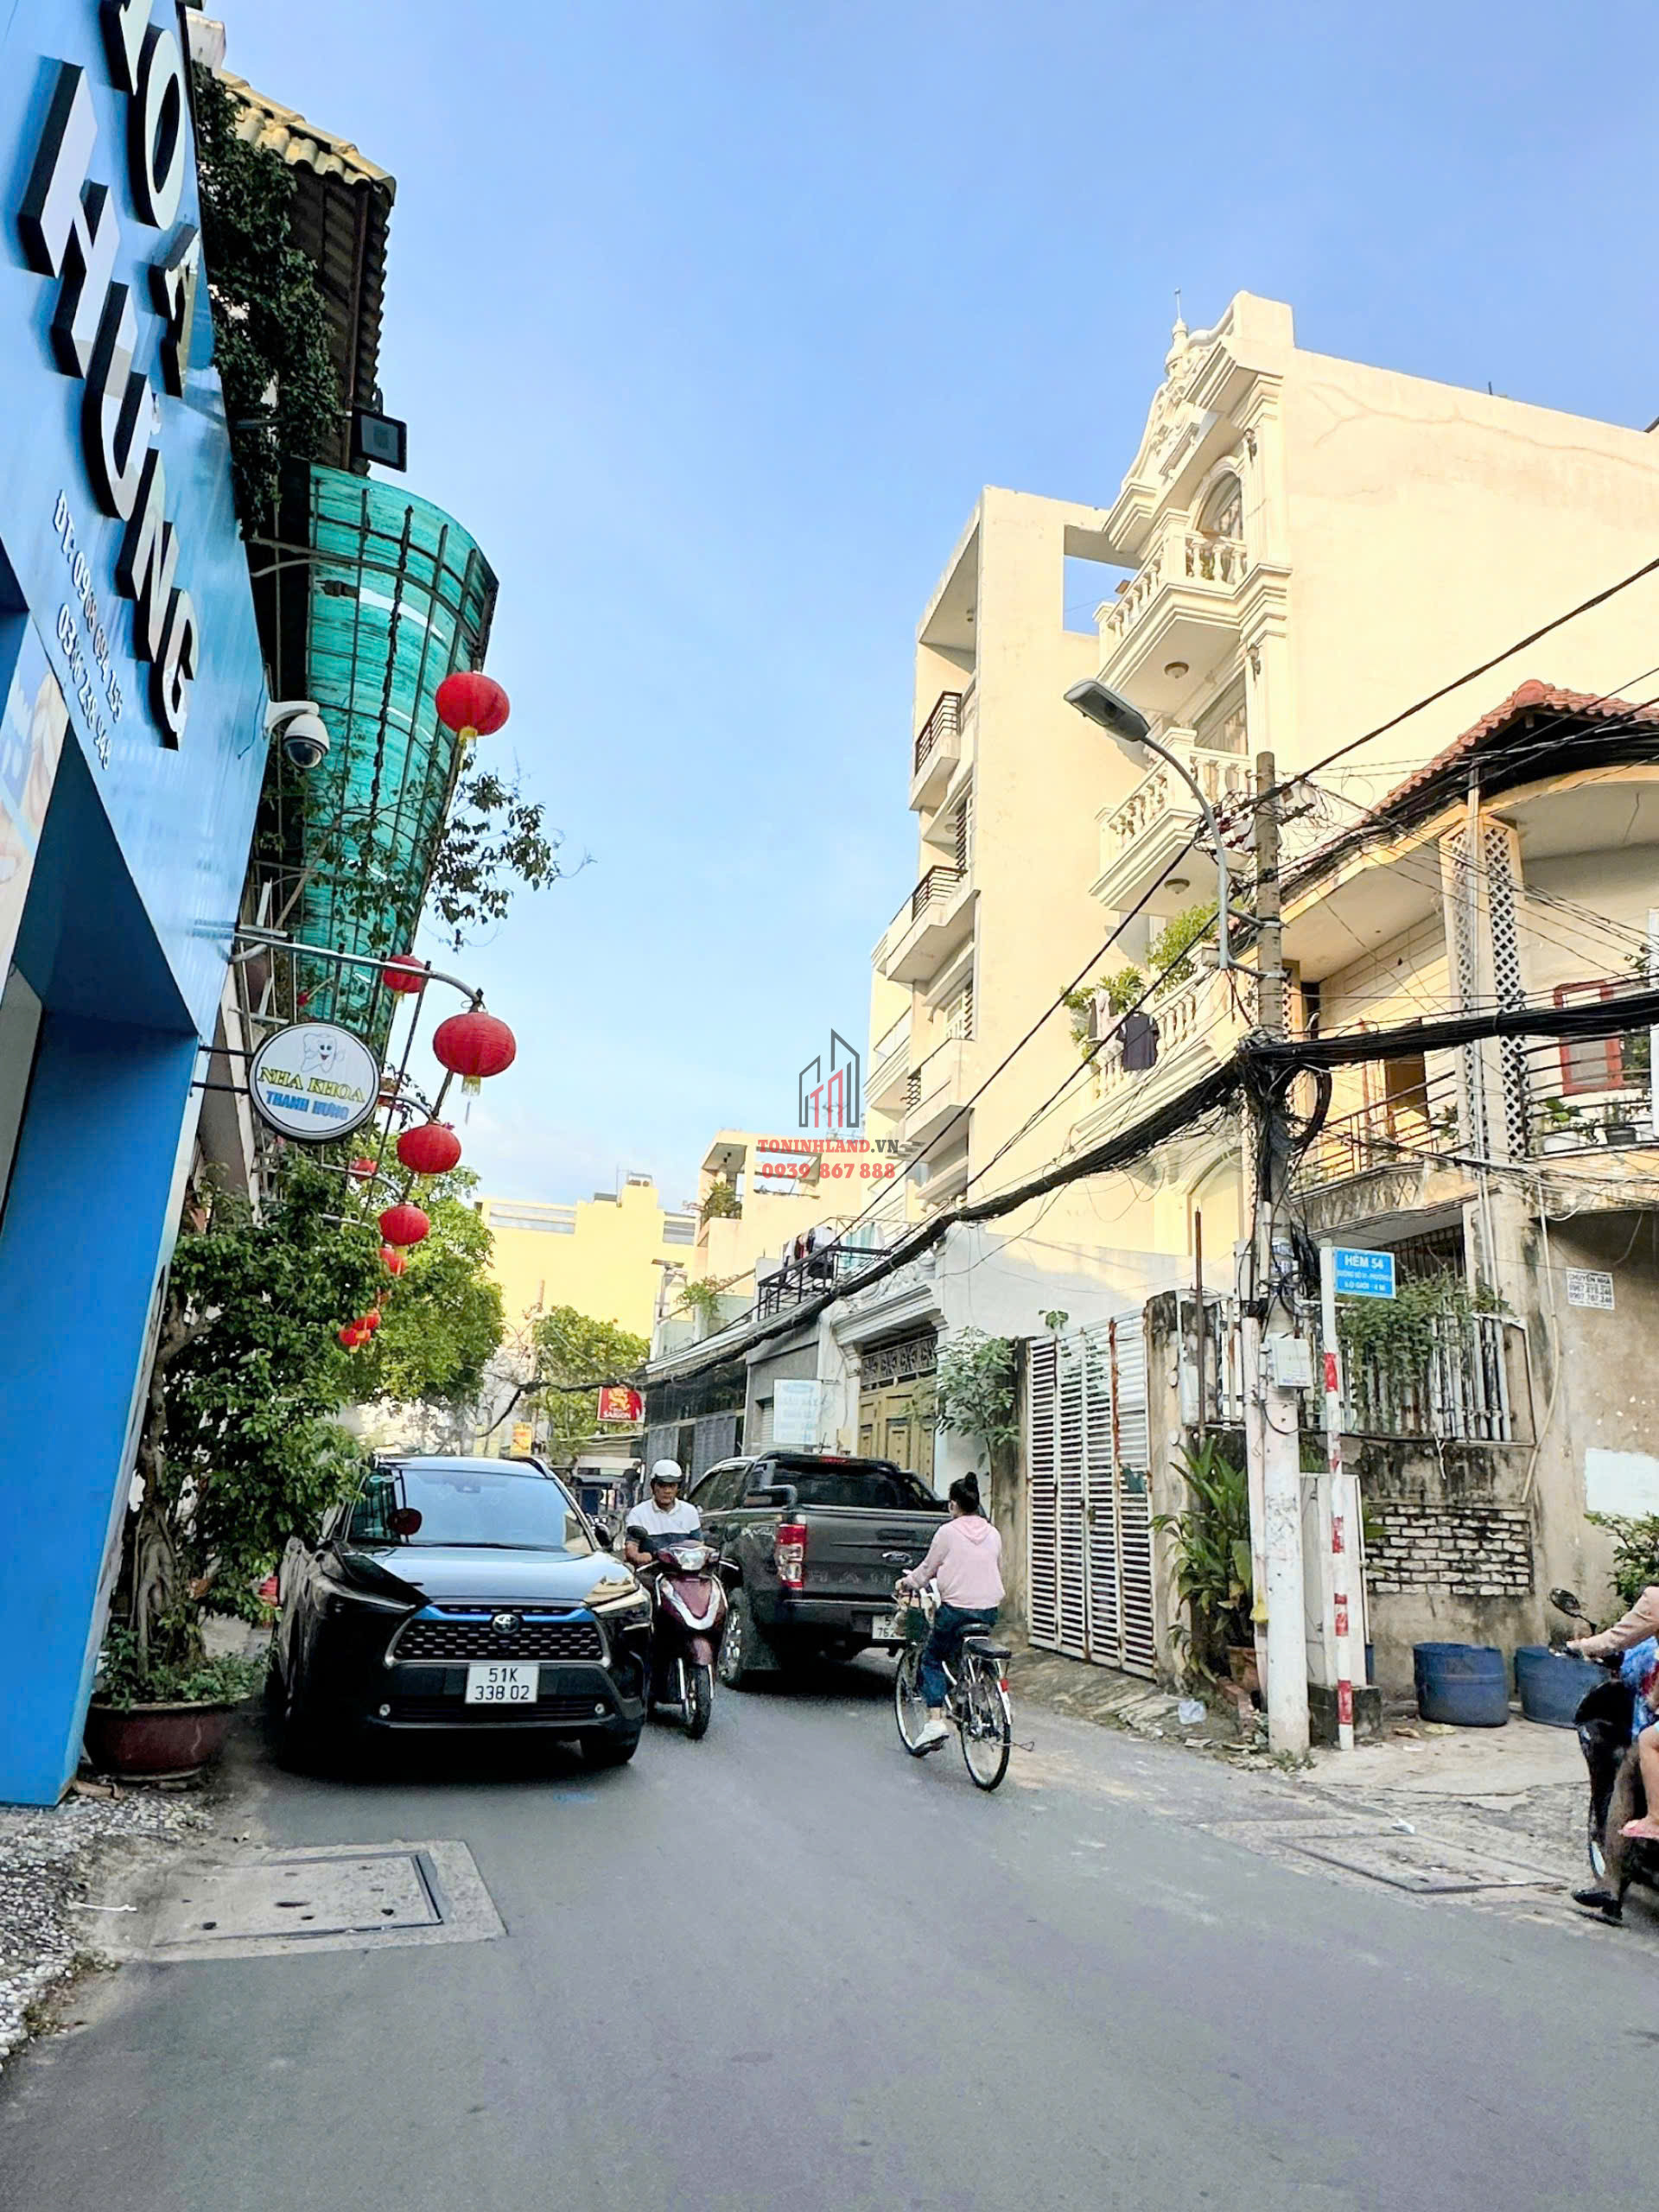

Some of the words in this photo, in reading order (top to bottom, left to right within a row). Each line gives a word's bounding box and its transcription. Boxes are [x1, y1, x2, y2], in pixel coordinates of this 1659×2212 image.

[258, 1066, 303, 1090] NHA
[307, 1077, 365, 1103] KHOA
[266, 1090, 309, 1113] THANH
[488, 1668, 518, 1683] 51K
